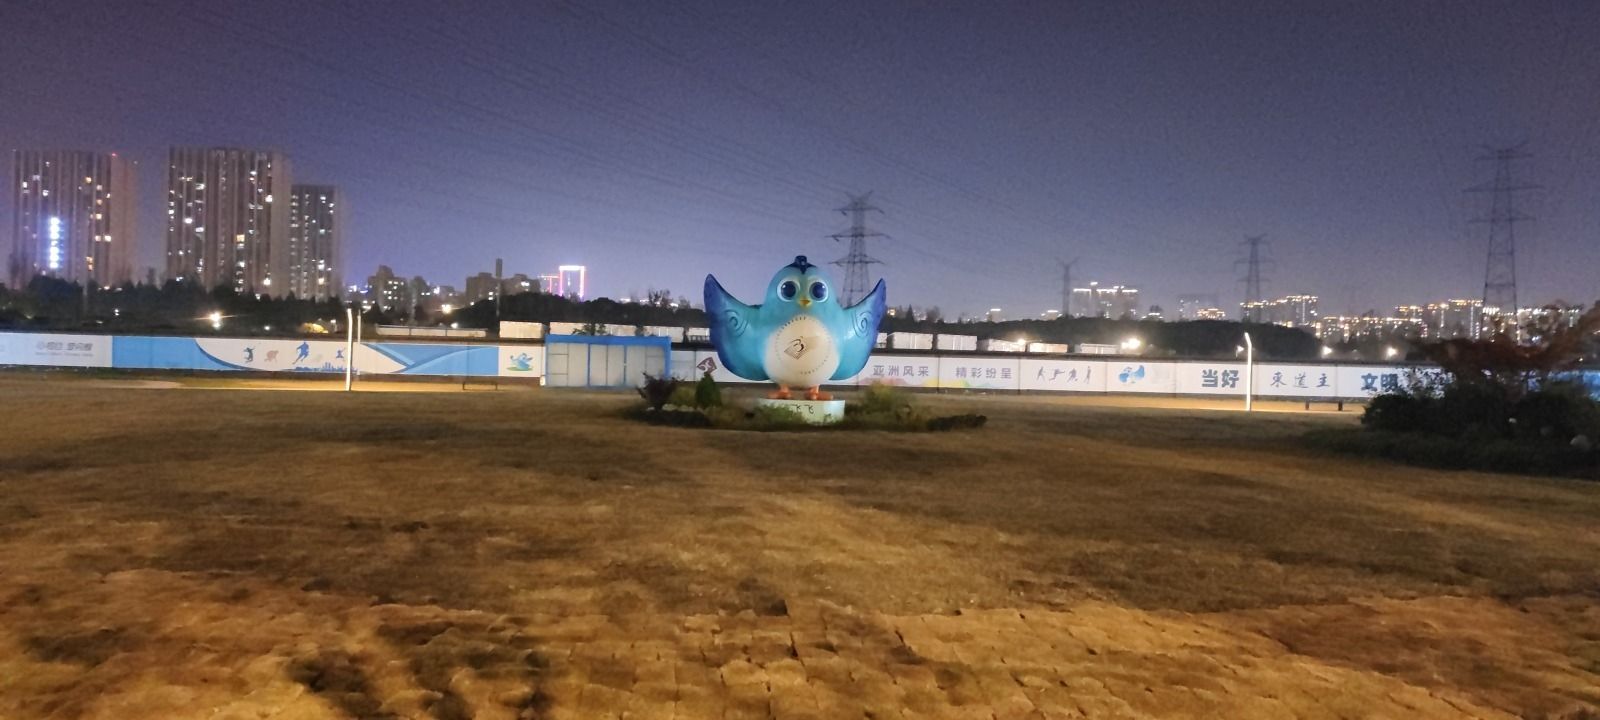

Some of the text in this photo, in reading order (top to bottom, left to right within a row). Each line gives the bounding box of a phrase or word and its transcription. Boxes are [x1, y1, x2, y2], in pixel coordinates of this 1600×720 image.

[873, 365, 1012, 379] 亚洲风采 精彩纷呈
[1201, 369, 1239, 388] 当好
